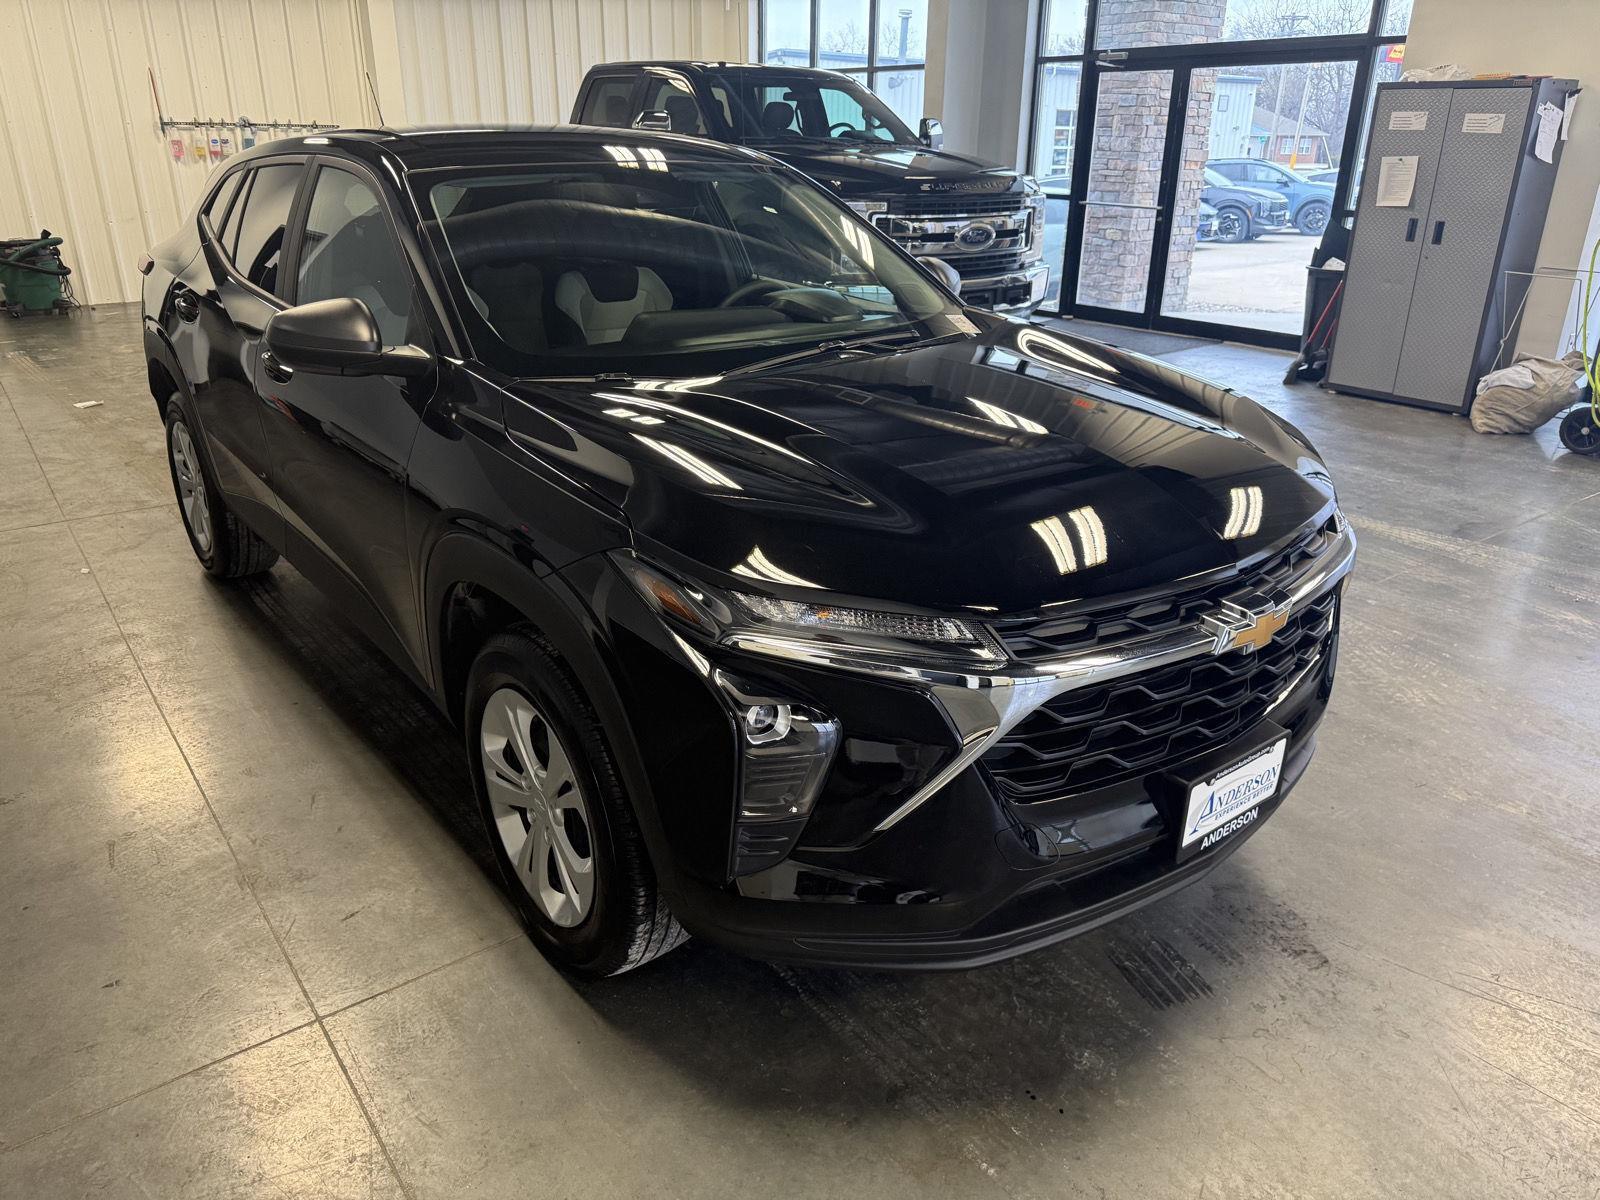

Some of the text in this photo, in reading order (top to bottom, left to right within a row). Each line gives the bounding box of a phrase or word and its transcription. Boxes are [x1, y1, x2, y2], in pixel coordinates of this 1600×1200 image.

[1189, 763, 1280, 836] ANDERSON
[1215, 783, 1274, 820] EXPERIENCE BETTER
[1200, 806, 1259, 850] ANDERSON
